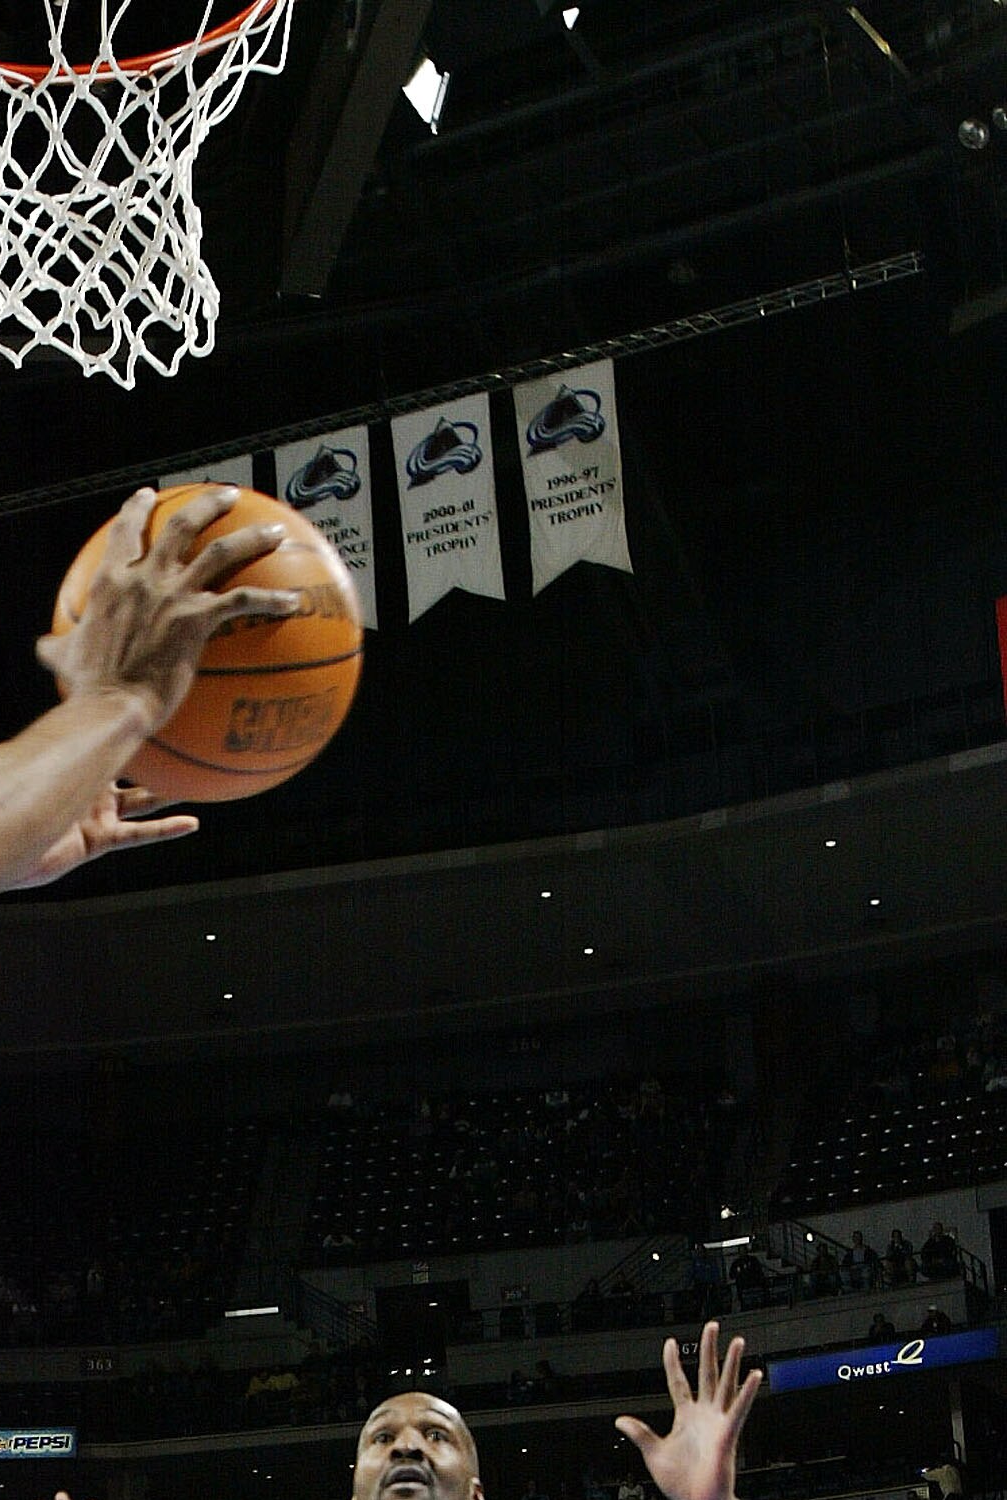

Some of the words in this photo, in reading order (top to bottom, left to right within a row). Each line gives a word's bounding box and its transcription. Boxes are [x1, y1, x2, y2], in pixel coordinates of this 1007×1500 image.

[422, 498, 475, 523] 2000-01
[548, 501, 603, 525] TROPHY
[426, 535, 477, 557] TROPHY
[682, 1342, 698, 1355] 67
[837, 1361, 892, 1380] Qwest
[13, 1435, 71, 1450] PEPSI
